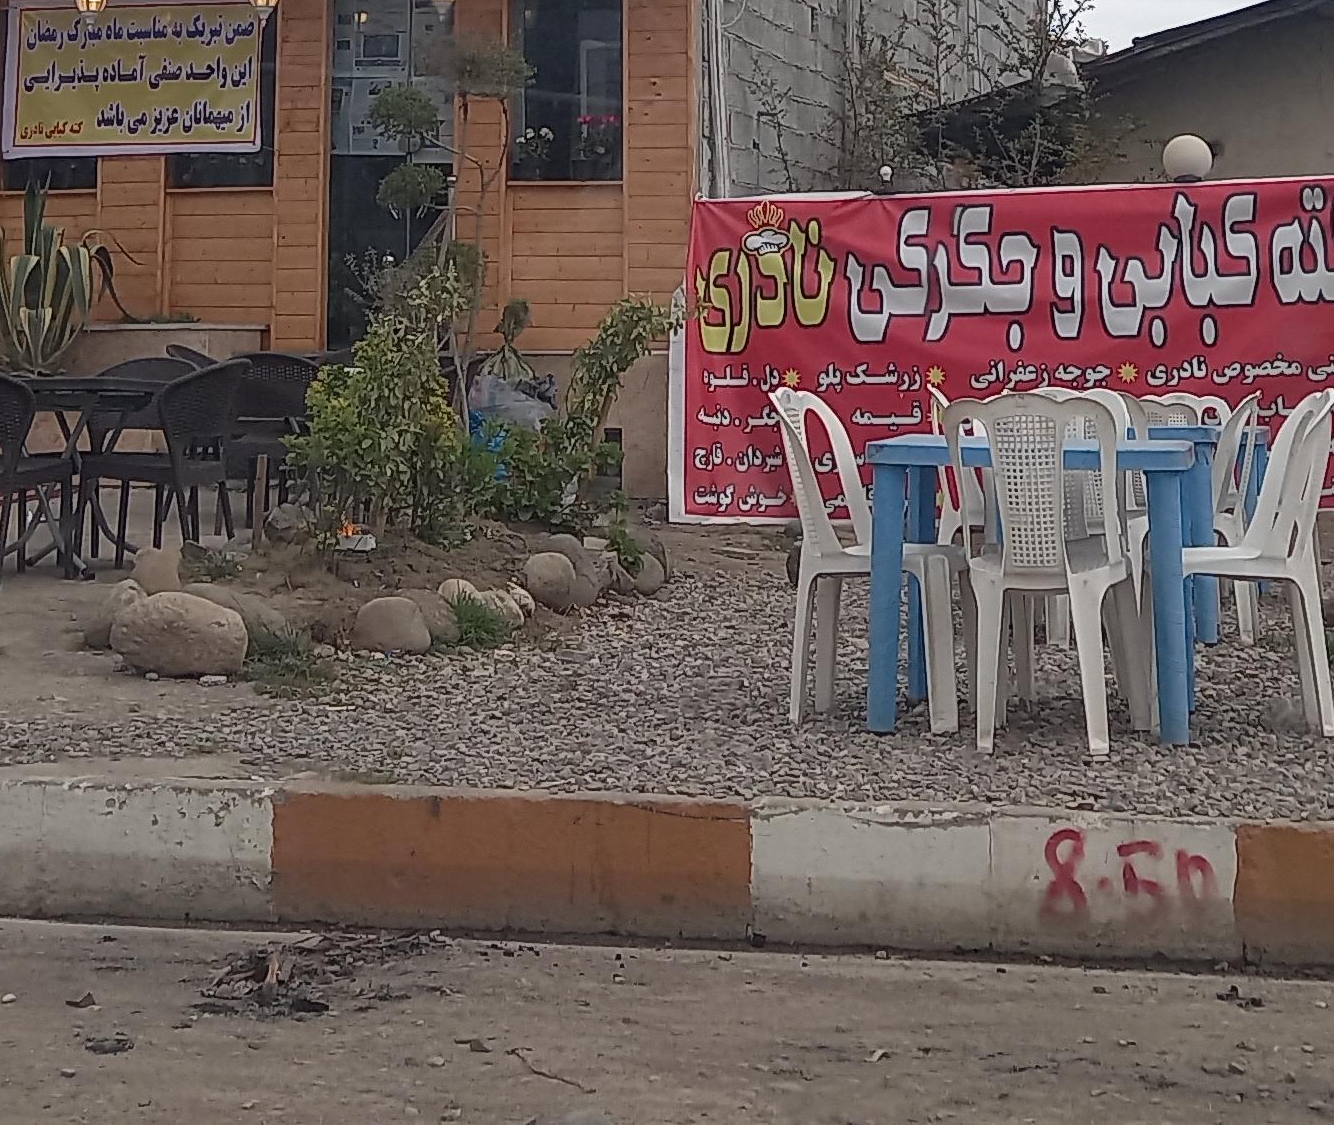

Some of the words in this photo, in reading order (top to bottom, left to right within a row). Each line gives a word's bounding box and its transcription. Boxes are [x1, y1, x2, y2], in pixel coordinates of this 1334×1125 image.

[26, 19, 65, 51] رمضان
[105, 17, 124, 41] ماه
[127, 14, 168, 46] مناسبت
[171, 20, 185, 46] به
[185, 14, 223, 47] تبریک
[225, 14, 255, 45] ضمن
[23, 59, 99, 93] پذیرایی
[101, 54, 147, 83] آماده
[148, 56, 183, 91] صنفی
[185, 56, 229, 89] واحد
[230, 55, 253, 87] این
[149, 106, 180, 135] عزیز
[182, 99, 234, 133] میهمانان
[236, 100, 251, 133] از
[695, 217, 836, 355] نادری
[844, 203, 1041, 352] جگرکی
[1051, 226, 1083, 339] و
[1095, 192, 1259, 348] کبابی
[816, 362, 842, 393] پلو
[845, 361, 922, 391] زرشک
[969, 359, 1050, 390] زعفرانی
[1053, 362, 1113, 388] جوجه
[1146, 356, 1208, 388] نادری
[1211, 352, 1302, 385] مخصوص
[851, 402, 922, 430] قیمه
[693, 441, 724, 472] قارچ
[694, 484, 735, 514] گوشت
[737, 484, 787, 513] خوش
